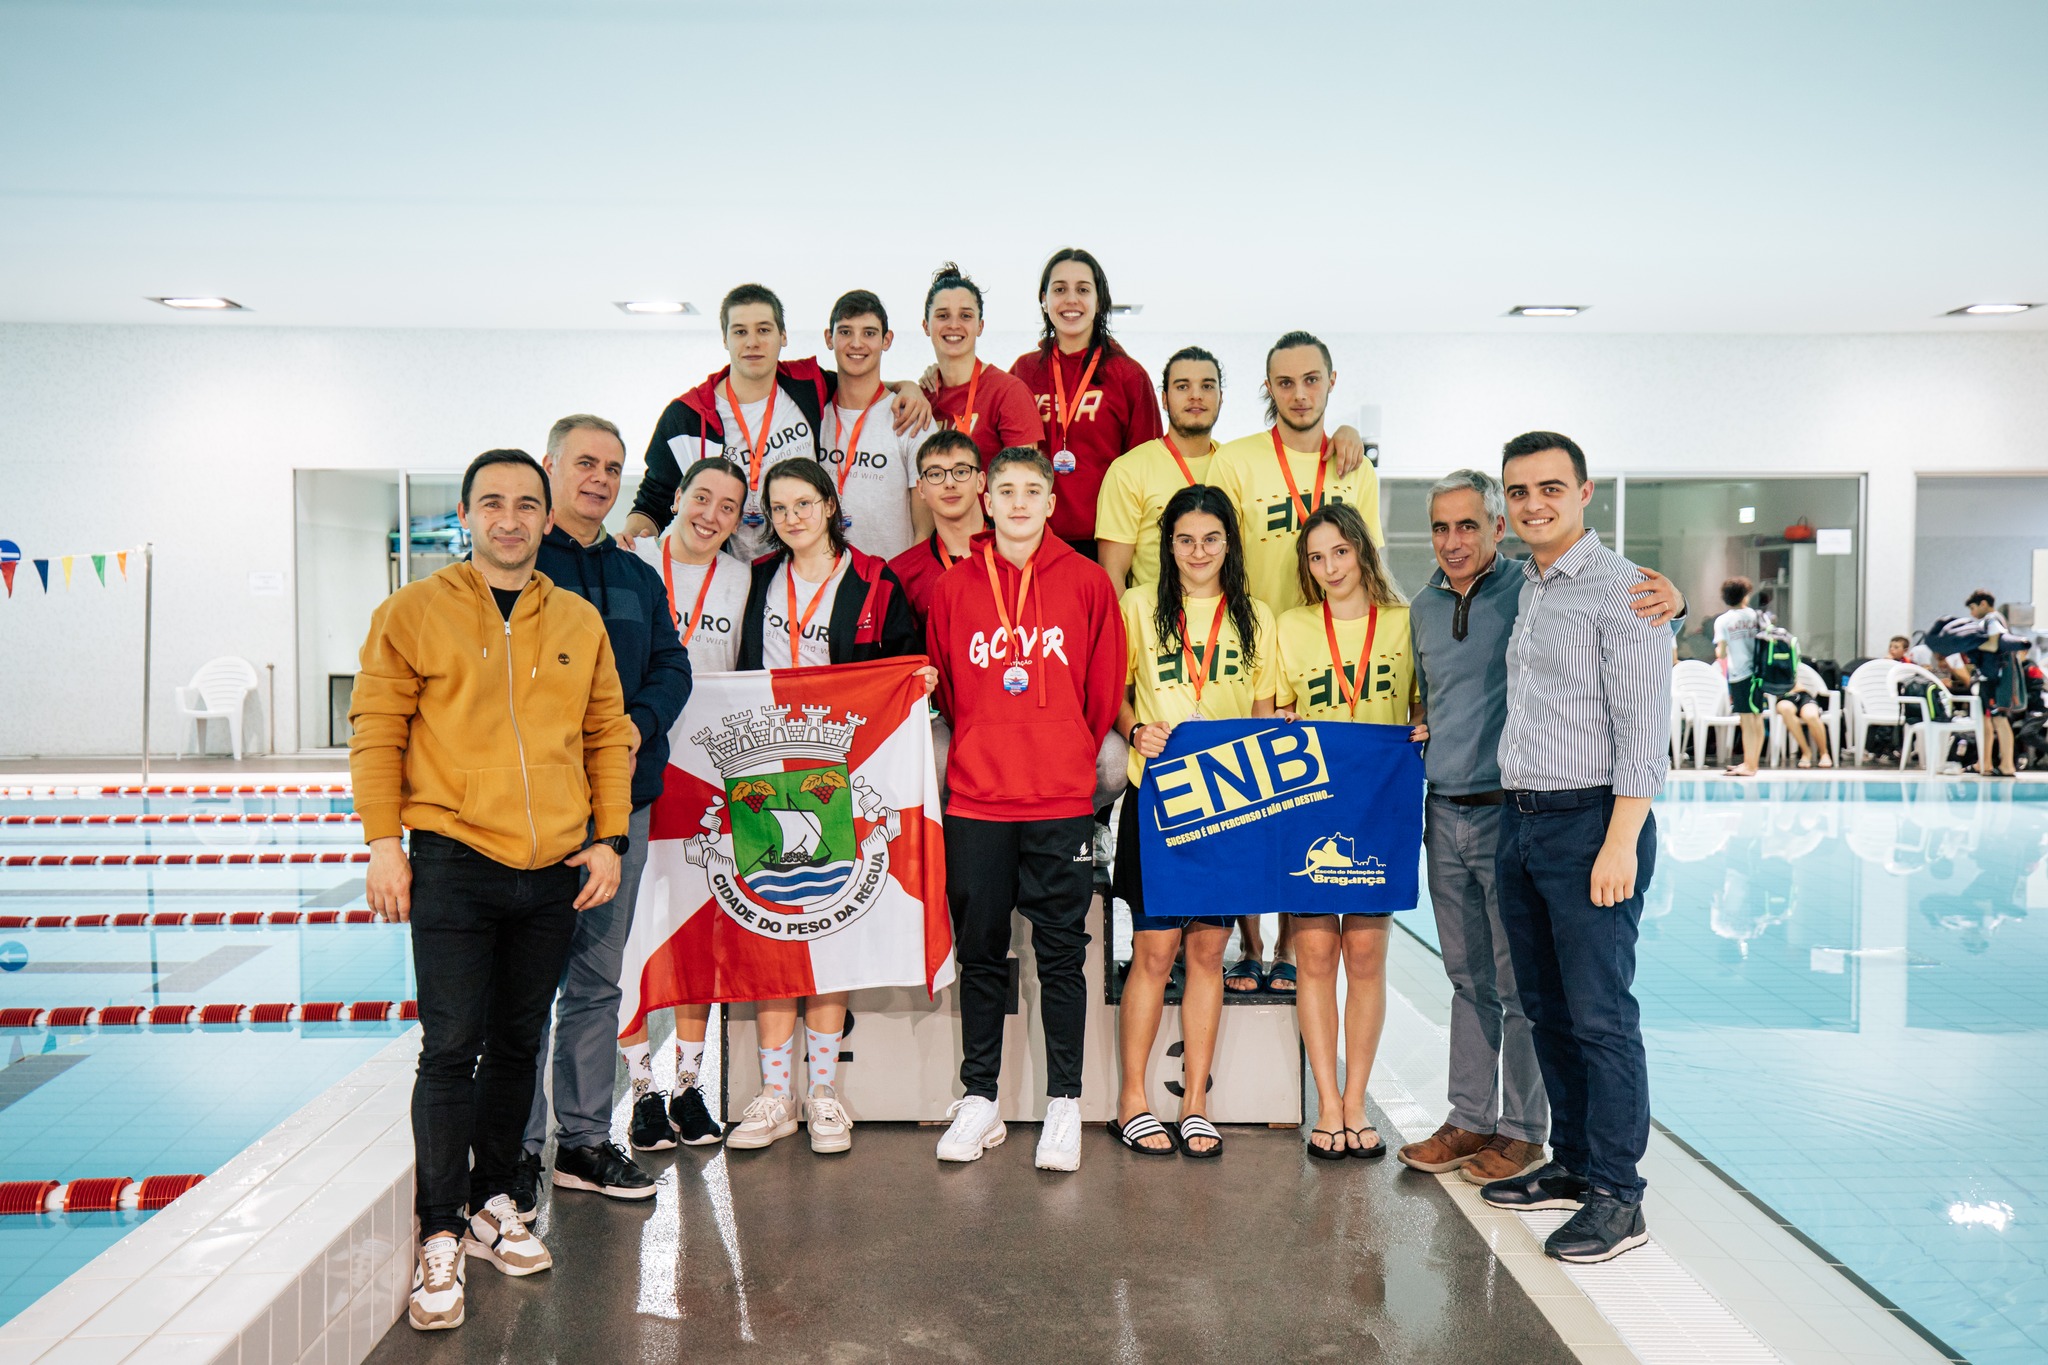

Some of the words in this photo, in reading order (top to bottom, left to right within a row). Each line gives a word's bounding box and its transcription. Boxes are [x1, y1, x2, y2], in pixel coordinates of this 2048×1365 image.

[861, 472, 885, 481] wine
[768, 613, 830, 643] DOUR
[969, 625, 1069, 668] GCVR
[1150, 726, 1320, 829] ENB
[1165, 831, 1202, 848] SUCESSO
[1200, 826, 1208, 838] É
[1207, 822, 1221, 835] UM
[1221, 809, 1262, 829] PERCURSO
[1266, 802, 1283, 816] NÃO
[1282, 799, 1295, 811] UM
[713, 873, 757, 924] CIDADE
[757, 917, 782, 933] DO
[787, 918, 832, 935] PESO
[834, 904, 858, 923] DA
[853, 851, 885, 904] RÉGUA
[1314, 873, 1386, 887] Bragança
